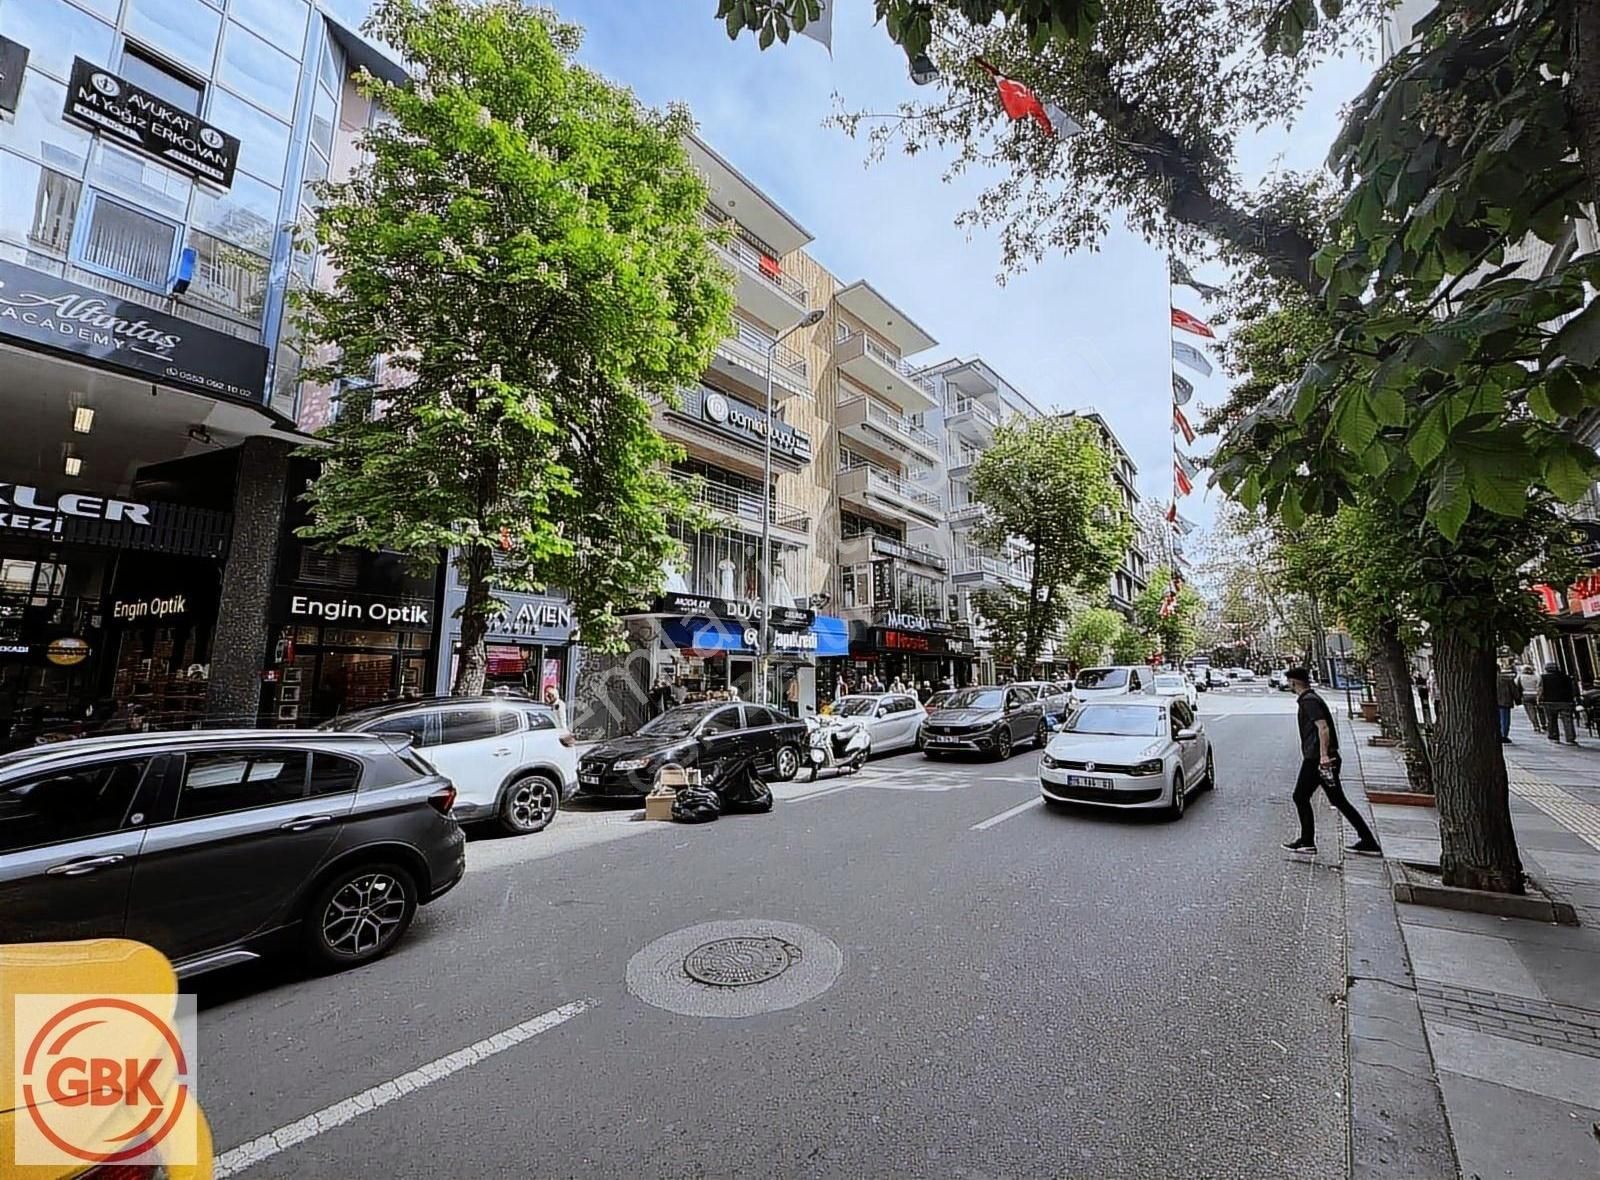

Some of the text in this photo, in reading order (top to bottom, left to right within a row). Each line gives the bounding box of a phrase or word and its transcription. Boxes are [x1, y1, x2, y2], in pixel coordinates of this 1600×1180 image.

[127, 93, 193, 132] AVUKAT
[151, 122, 228, 168] ERKOVAN
[1, 306, 126, 350] ACADEMY
[114, 597, 185, 620] Engin Optik
[292, 597, 428, 624] Engin Optik
